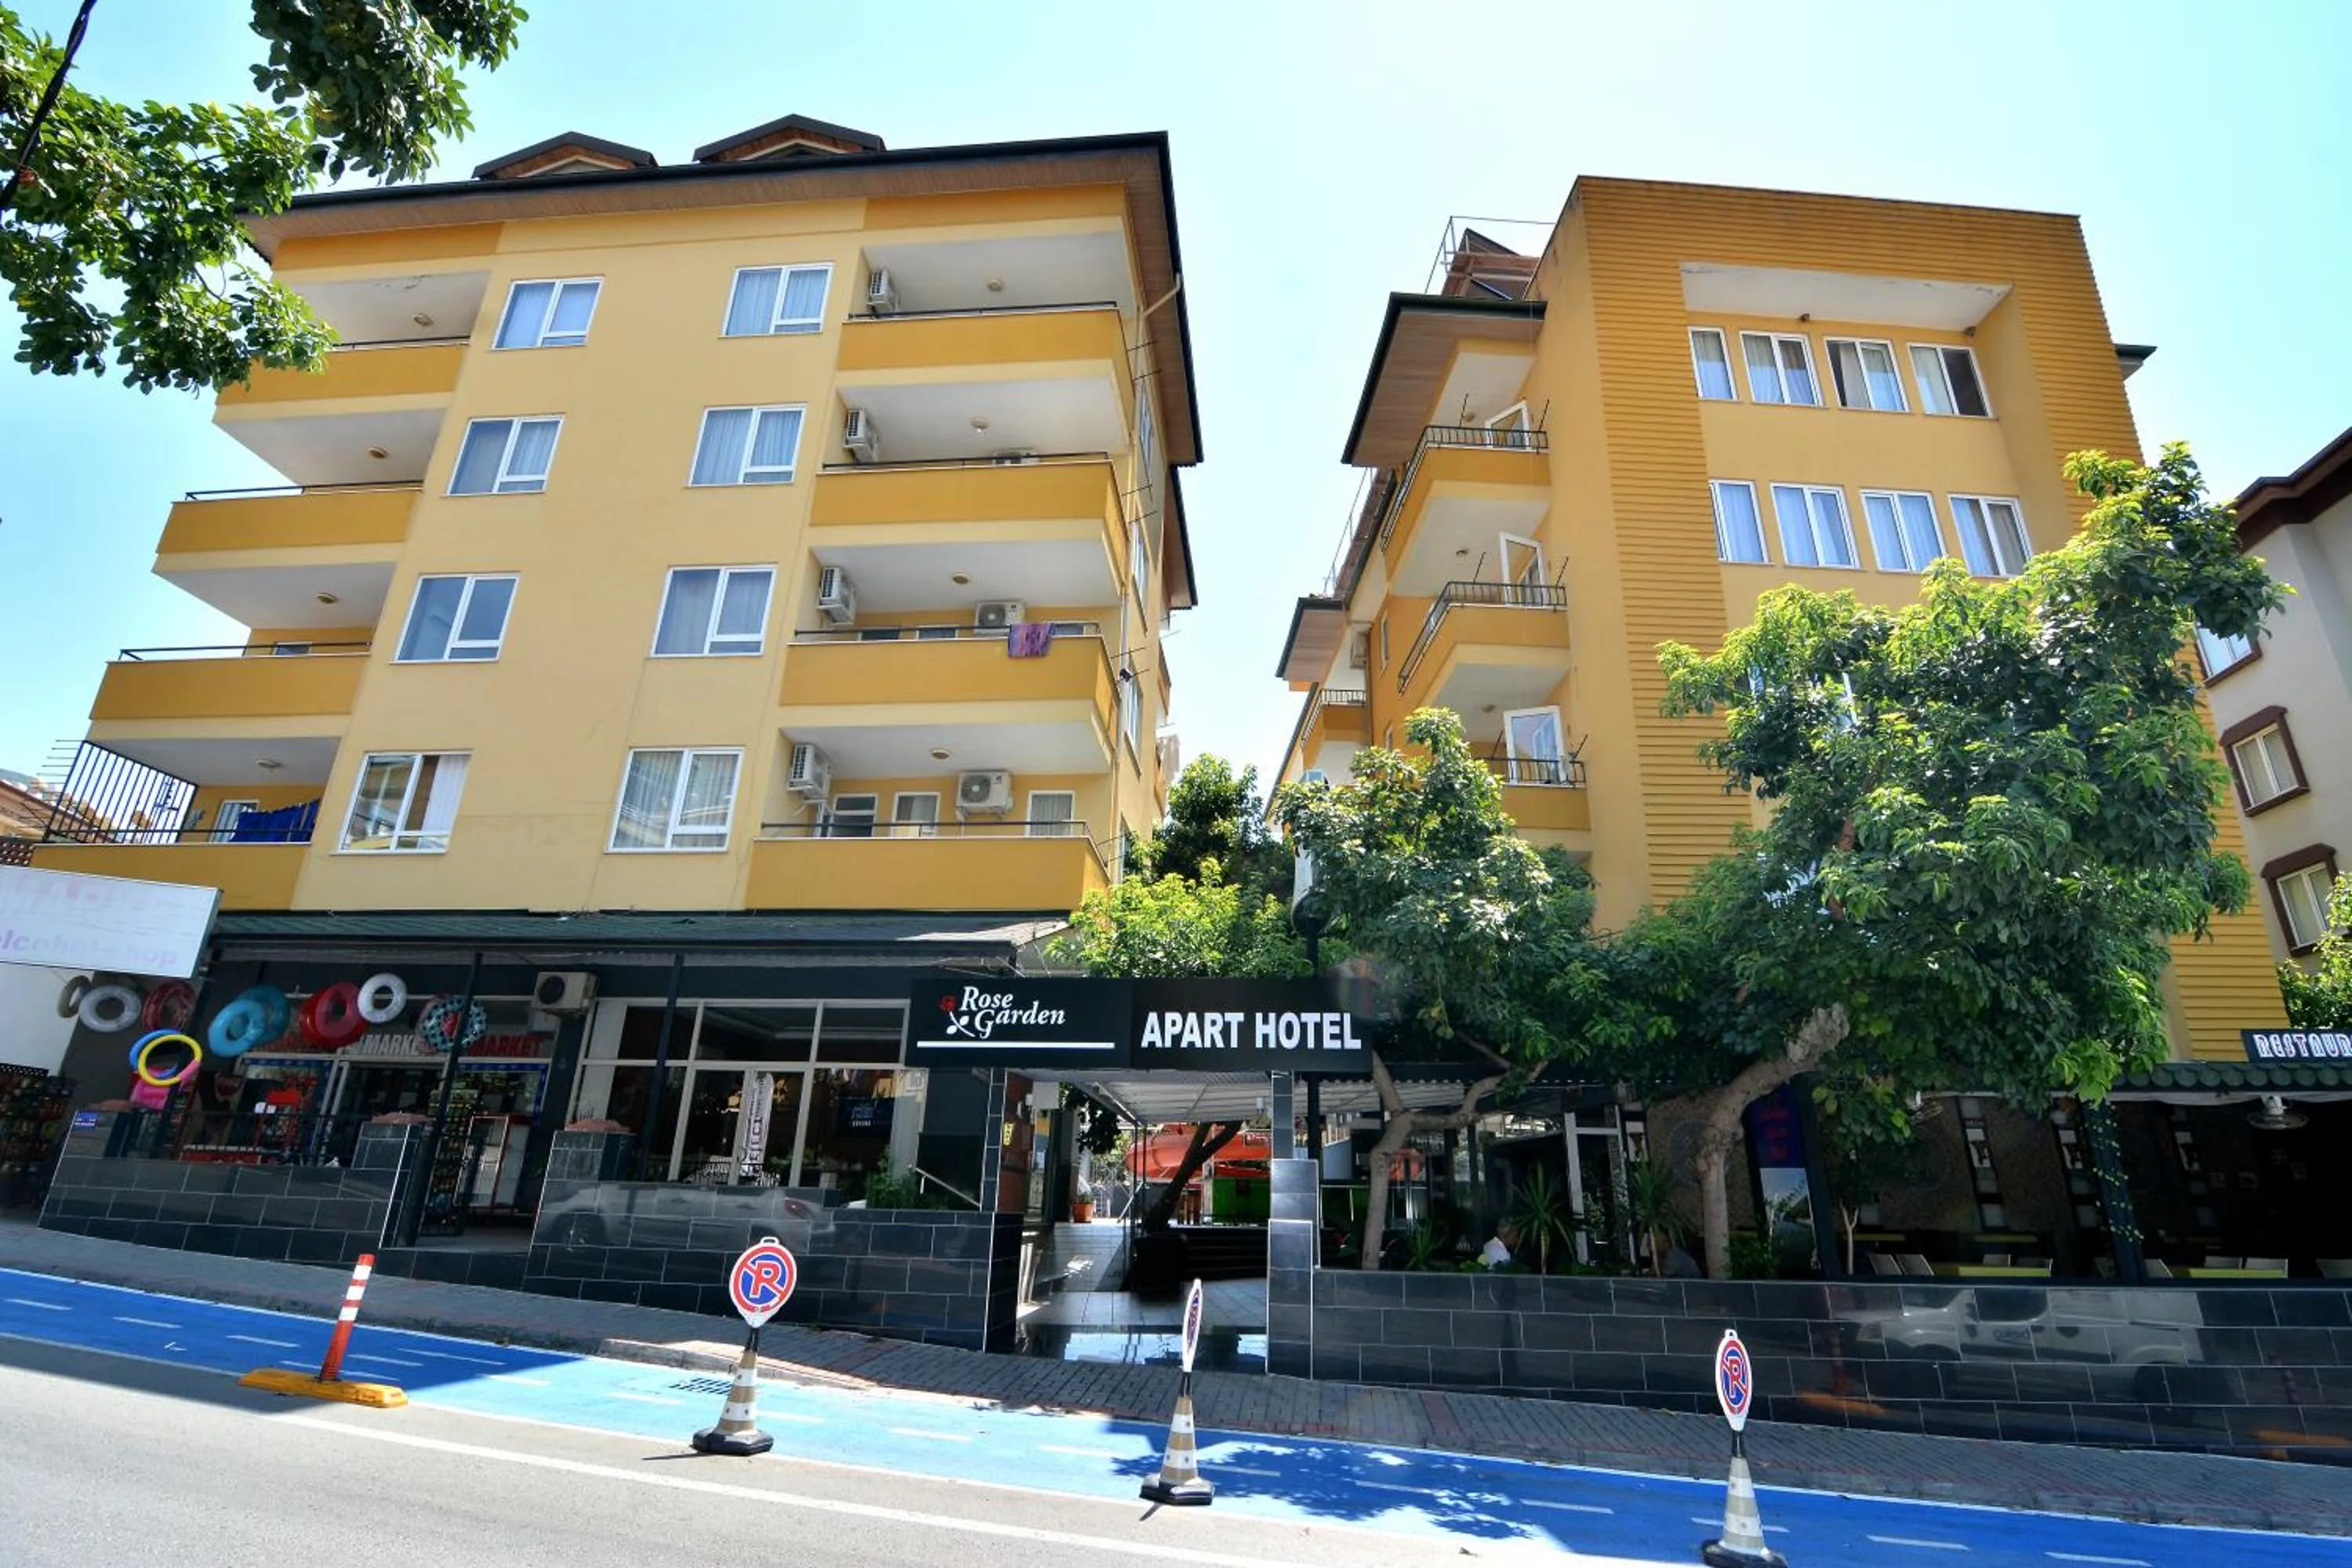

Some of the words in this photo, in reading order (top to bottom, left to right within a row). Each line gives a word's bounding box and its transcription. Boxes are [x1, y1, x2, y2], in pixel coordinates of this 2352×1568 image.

[959, 985, 1014, 1011] Rose
[974, 1000, 1066, 1040] Garden
[1140, 1011, 1245, 1049] APART
[1254, 1011, 1363, 1050] HOTEL
[2252, 1033, 2352, 1058] RESTAUR
